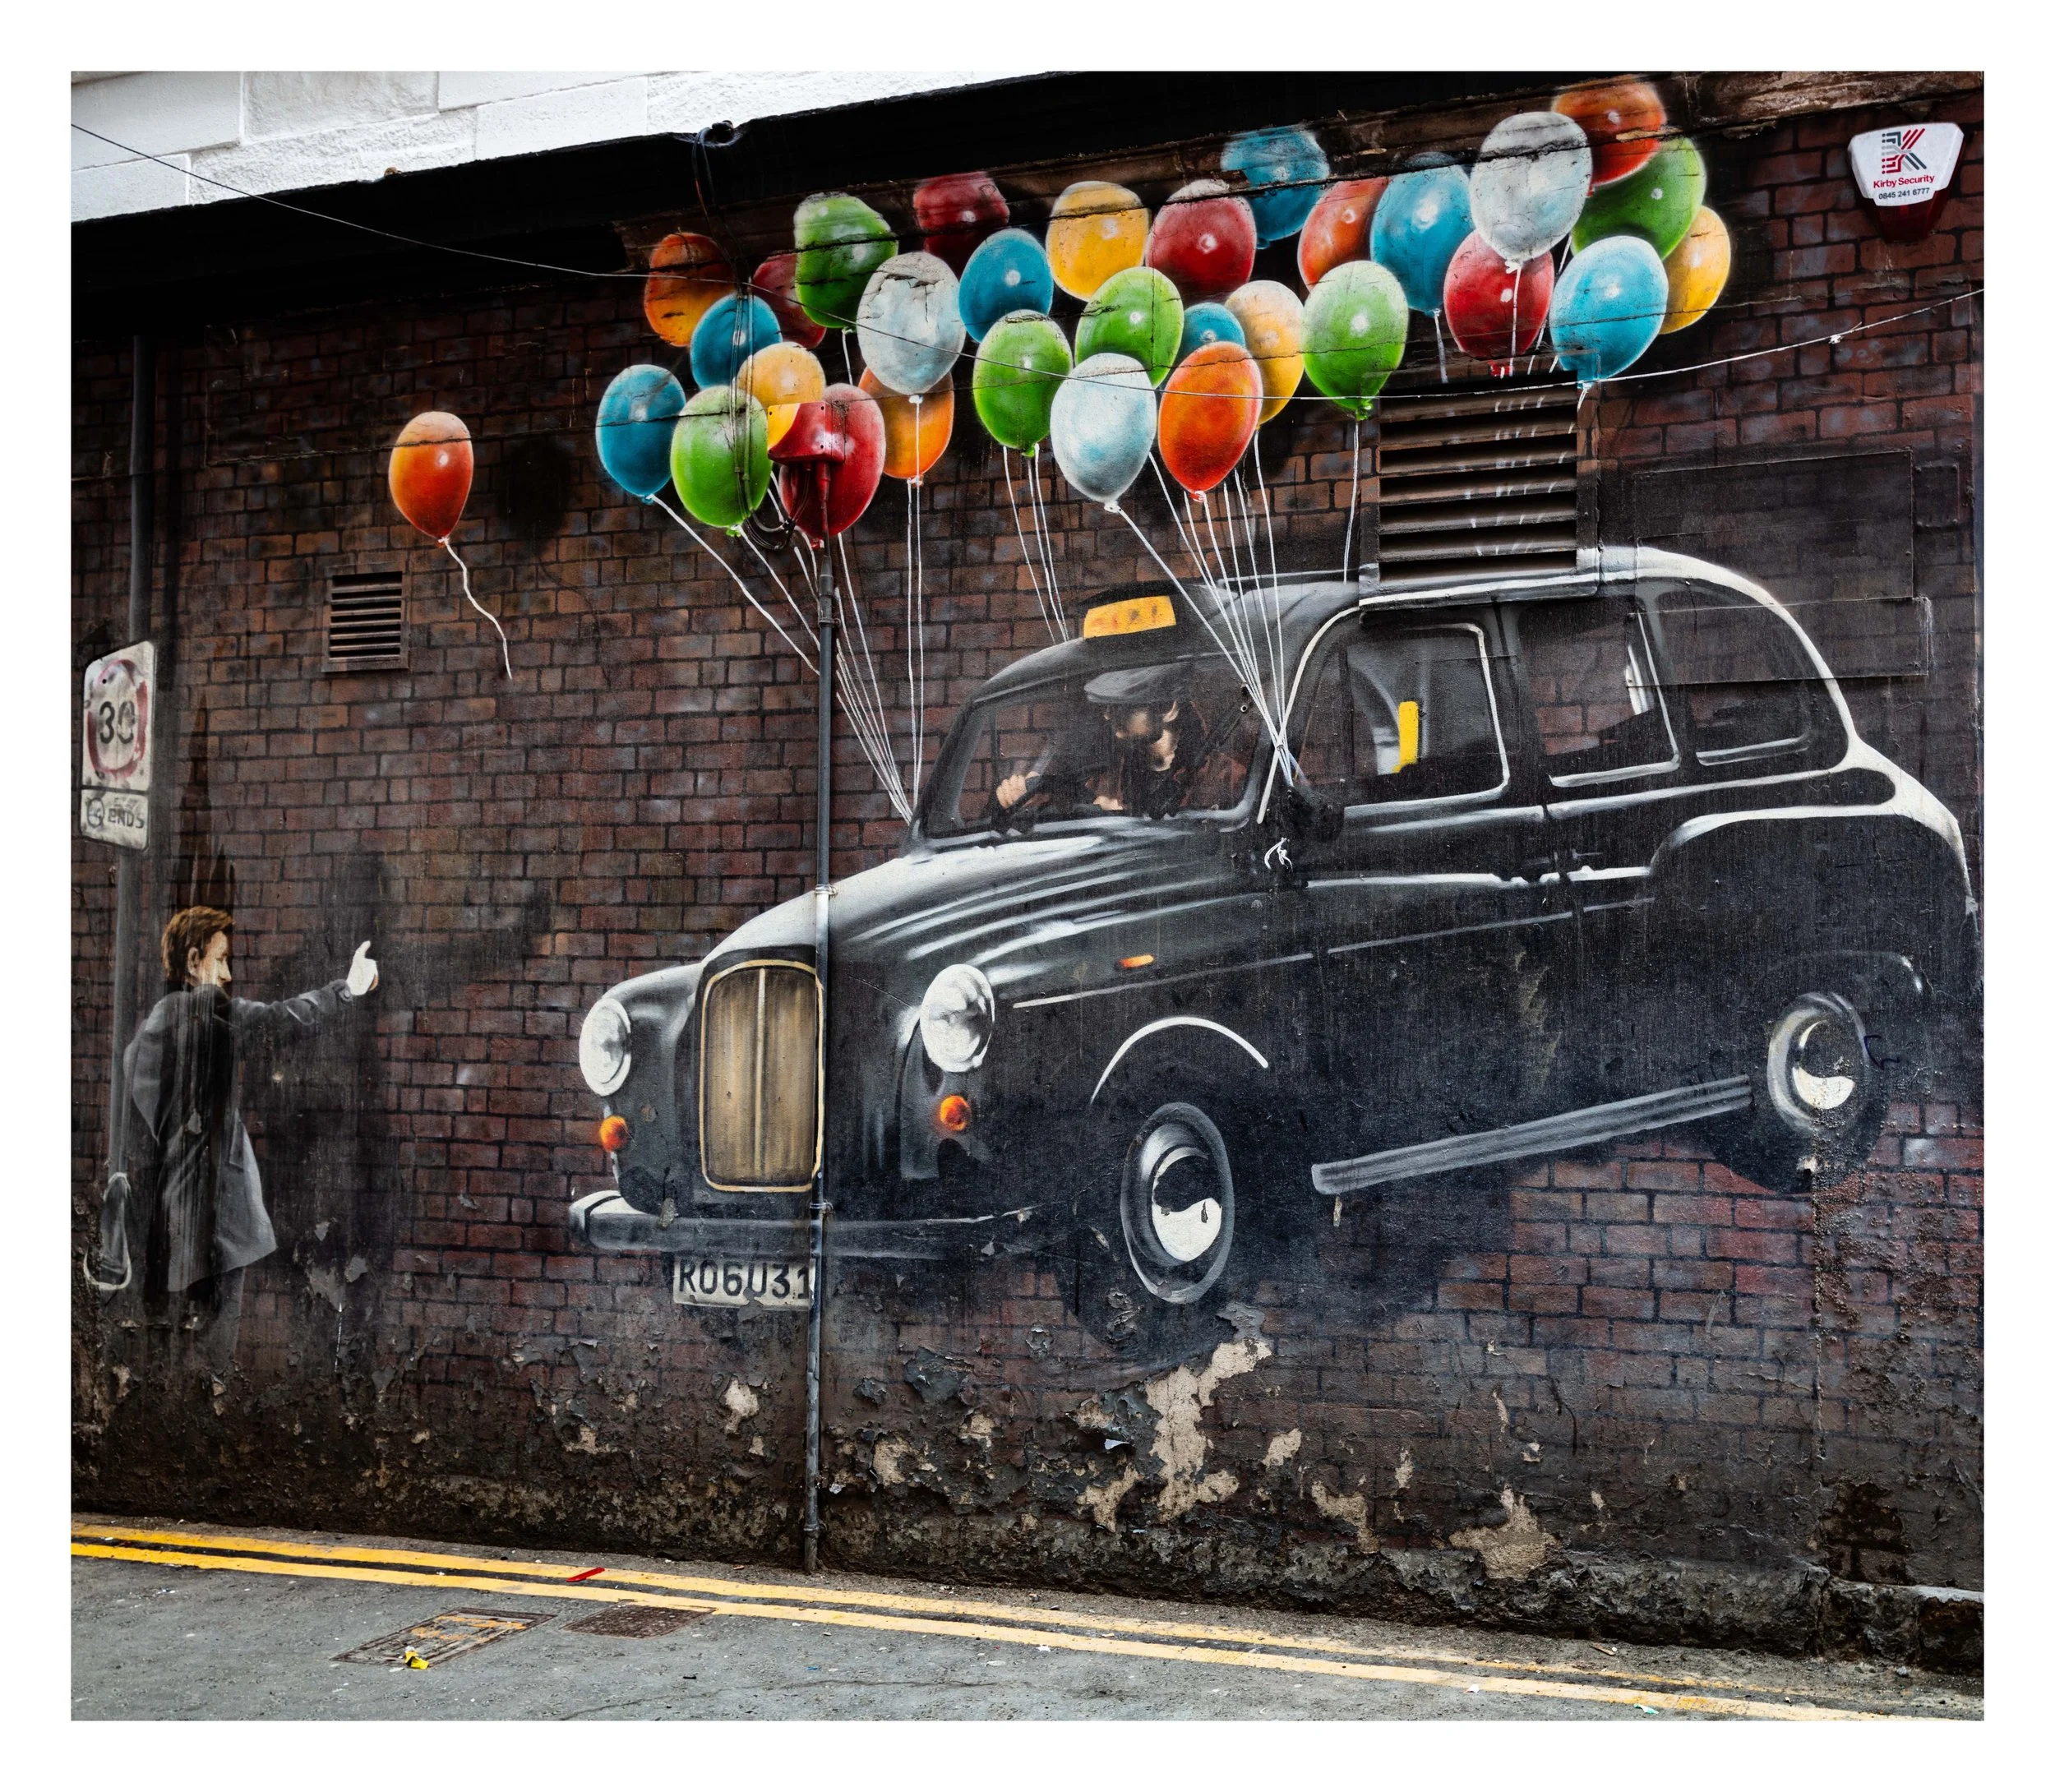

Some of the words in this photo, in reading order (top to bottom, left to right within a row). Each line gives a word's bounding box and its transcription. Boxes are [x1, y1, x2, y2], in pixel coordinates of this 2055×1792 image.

[1873, 178, 1897, 188] Kirby
[1898, 175, 1935, 186] Security
[1878, 192, 1896, 200] 0845
[1913, 187, 1930, 196] 6777
[99, 700, 135, 744] 30
